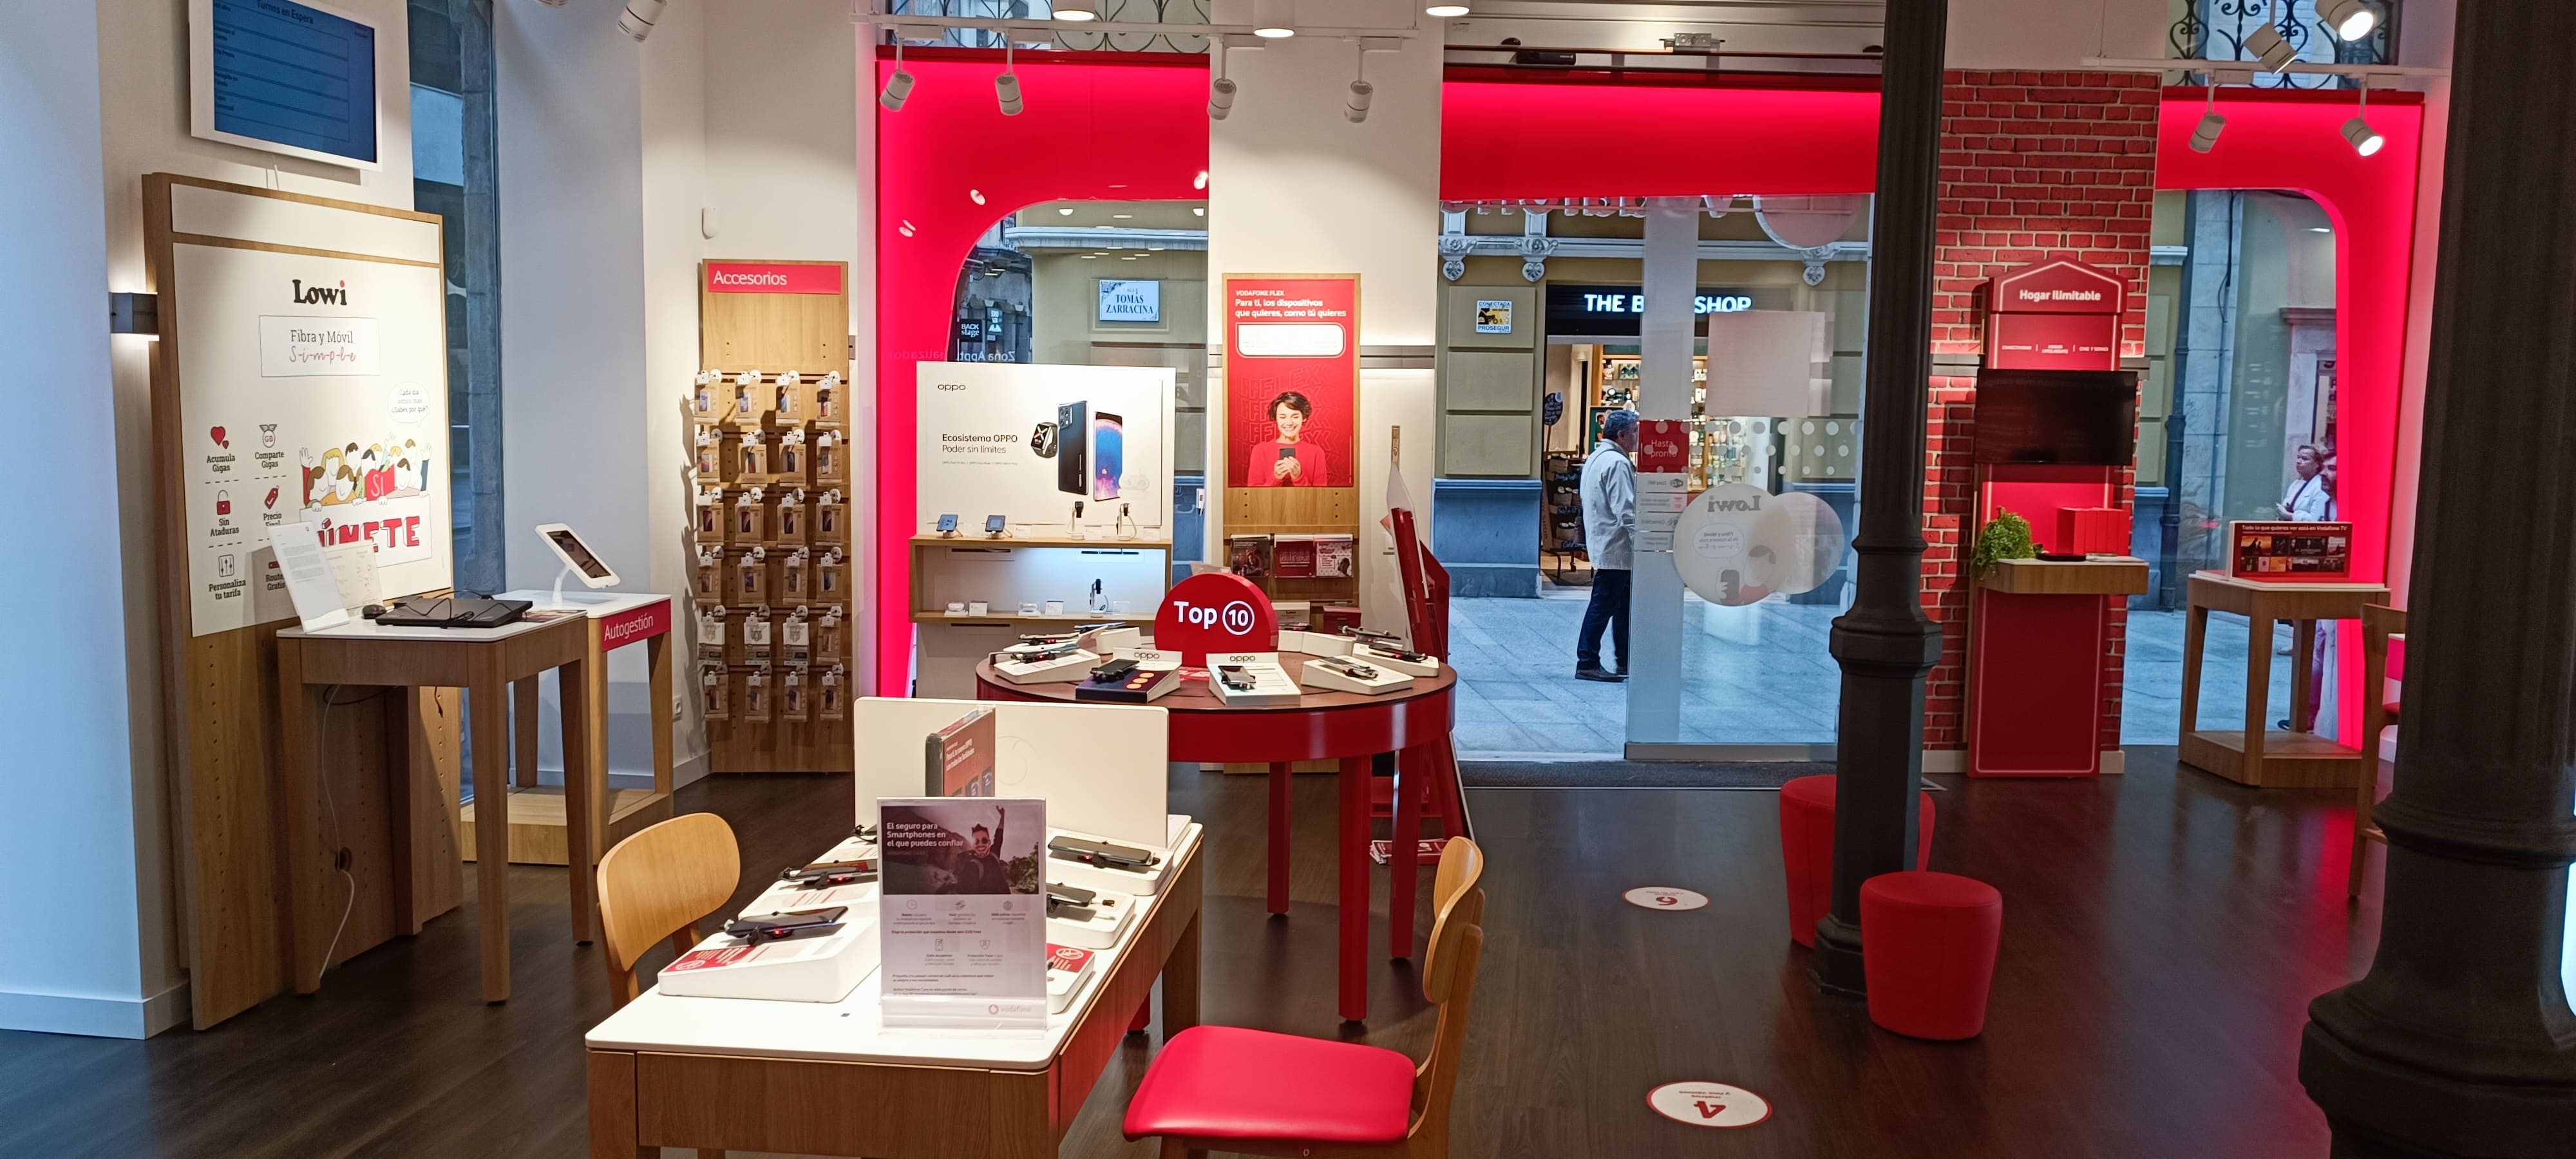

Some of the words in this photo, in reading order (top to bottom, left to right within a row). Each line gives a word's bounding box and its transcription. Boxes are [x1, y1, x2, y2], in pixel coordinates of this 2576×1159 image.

[291, 9, 314, 24] Espera
[712, 270, 788, 286] Accesorios
[292, 279, 347, 306] Lowi
[2020, 289, 2051, 302] Hogar
[2052, 290, 2101, 301] Ilimitable
[1115, 292, 1144, 304] TOMÁS
[1584, 294, 1625, 312] THE
[1254, 299, 1262, 308] ti,
[1276, 299, 1323, 308] dispositivos
[1694, 296, 1752, 314] SHOP
[1106, 304, 1153, 314] ZARRACINA
[1235, 310, 1250, 319] que
[1251, 309, 1283, 319] quieres,
[1308, 309, 1316, 317] tú
[1317, 309, 1347, 319] quieres
[290, 329, 316, 343] Fibra
[319, 333, 325, 345] y
[327, 330, 354, 343] Móvil
[961, 328, 980, 338] stage
[942, 433, 991, 442] Ecosistema
[993, 434, 1018, 443] OPPO
[942, 444, 965, 453] Poder
[967, 445, 979, 453] sin
[980, 444, 1007, 453] límites
[1651, 439, 1674, 448] Hasta
[206, 453, 236, 464] Acumula
[254, 451, 285, 460] Comparte
[212, 464, 231, 473] Gigas
[261, 460, 278, 469] Gigas
[263, 511, 282, 521] Precio
[218, 518, 230, 527] Sin
[210, 527, 240, 537] Ataduras
[265, 573, 284, 583] Route
[209, 579, 246, 592] Personaliza
[267, 581, 286, 591] Gratis
[223, 589, 241, 599] tarifa
[1173, 601, 1218, 630] Top
[1228, 609, 1249, 627] 10
[604, 612, 654, 641] Autogestión
[1229, 655, 1256, 663] oppo
[911, 840, 937, 848] puedes
[1693, 1100, 1727, 1119] 4
